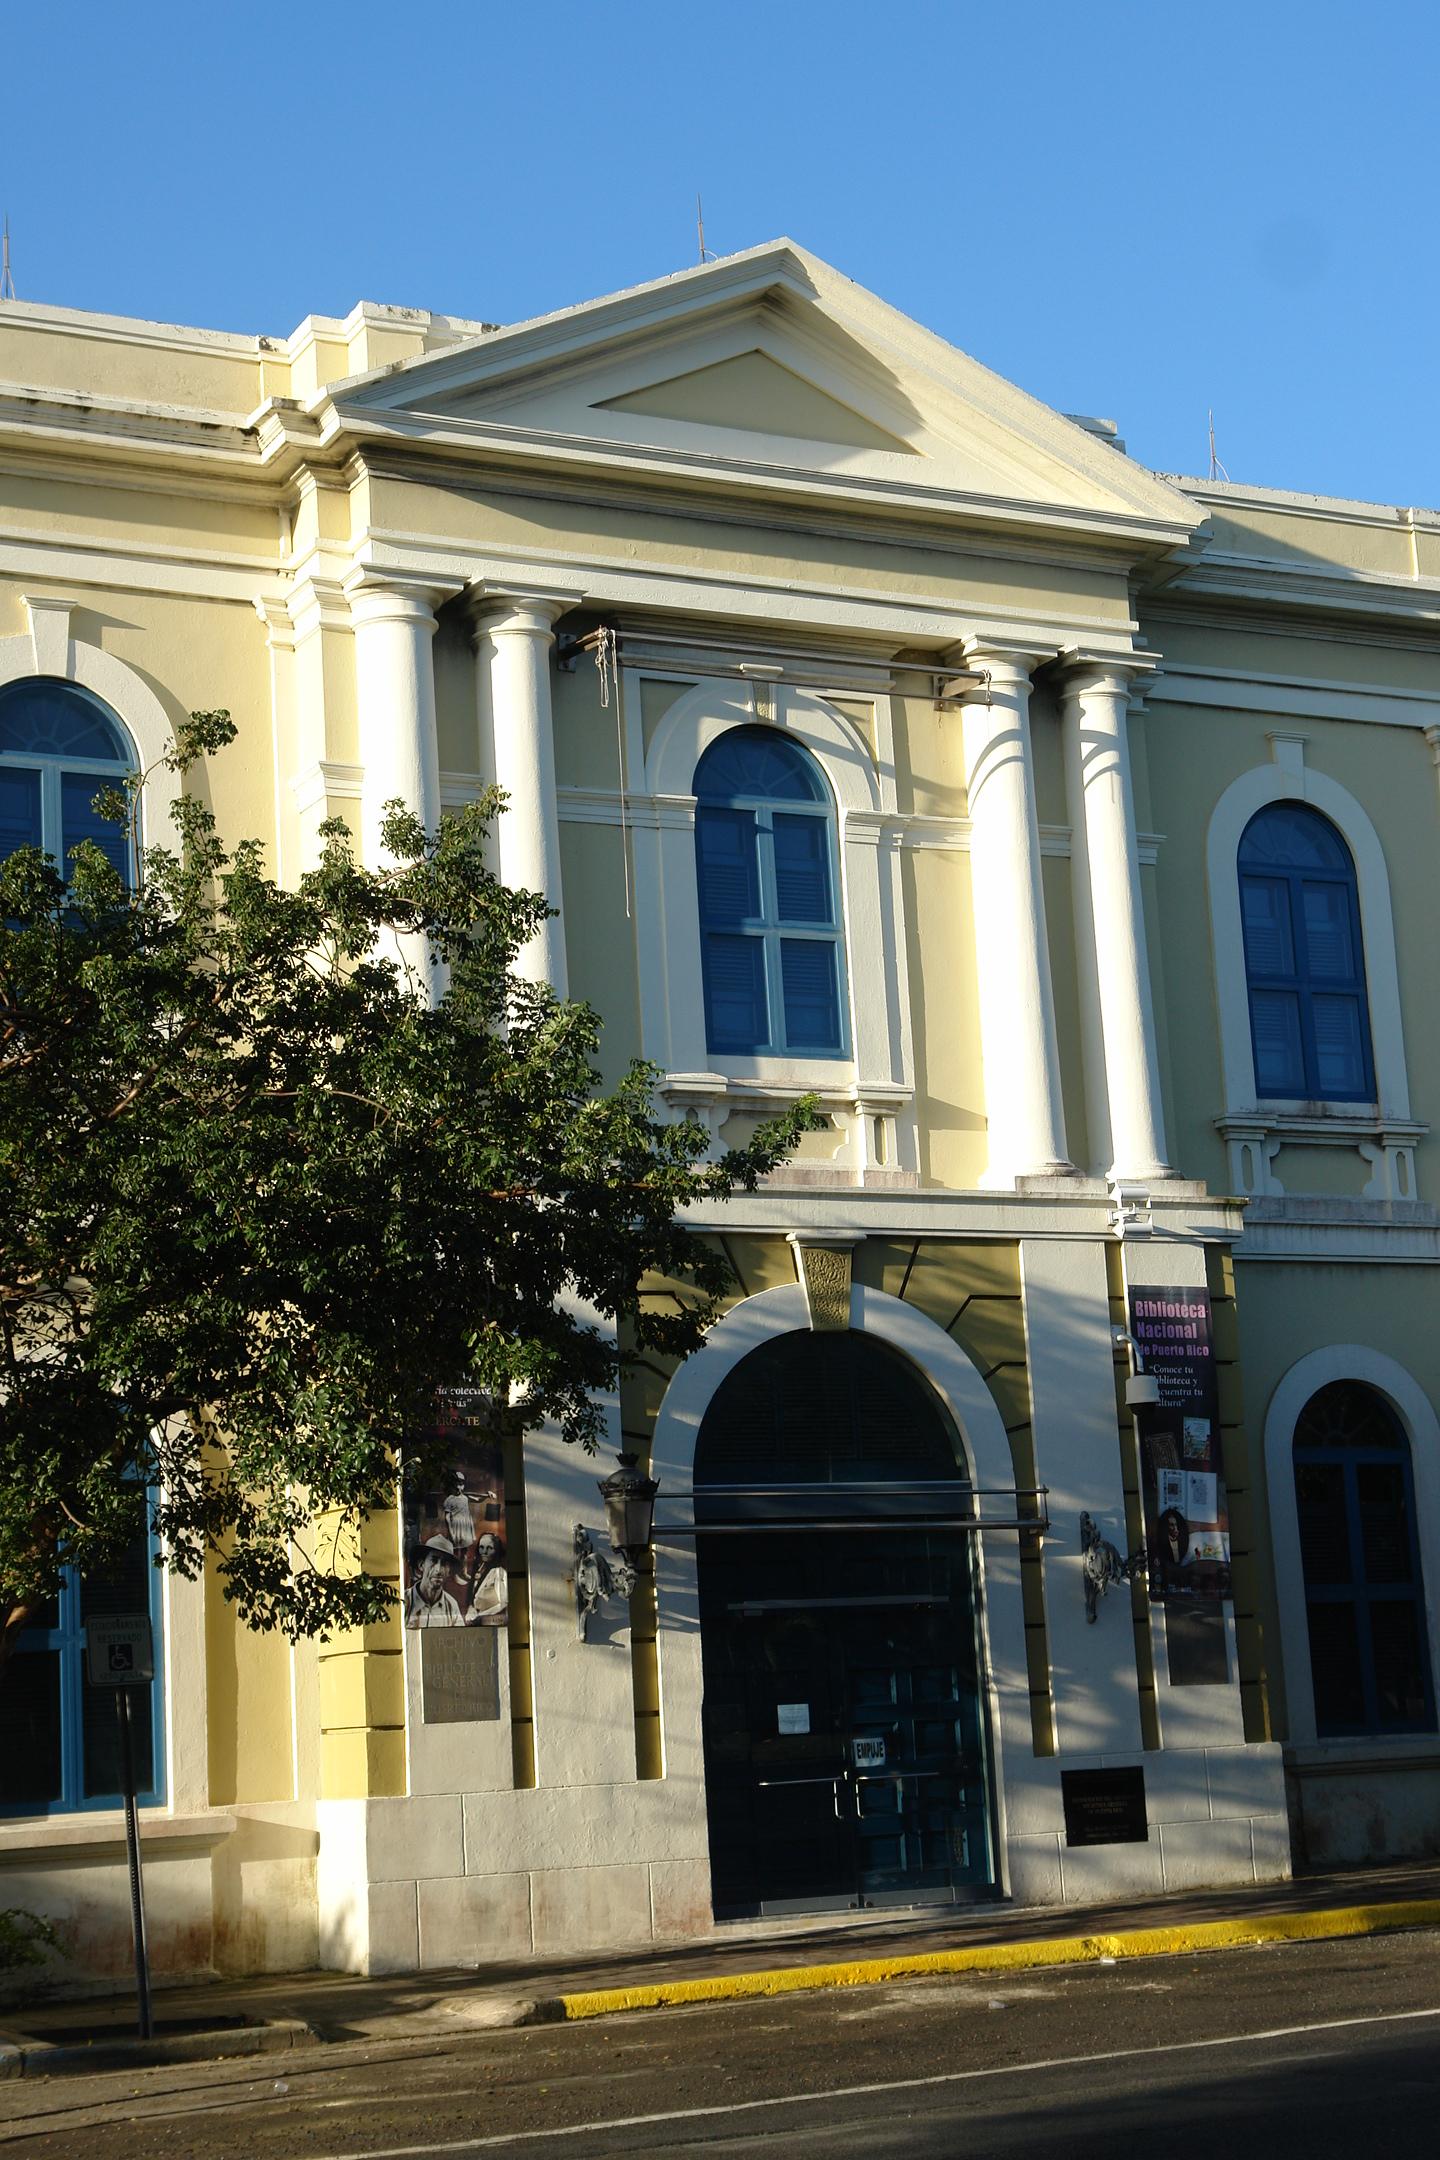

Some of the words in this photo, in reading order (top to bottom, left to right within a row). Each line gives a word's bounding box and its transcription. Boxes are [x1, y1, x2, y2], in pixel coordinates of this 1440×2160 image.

[1135, 1301, 1206, 1318] Biblioteca
[1137, 1321, 1198, 1339] Nacional
[1152, 1344, 1185, 1356] Puerto
[1187, 1345, 1210, 1356] Rico
[1184, 1366, 1194, 1374] tu
[1155, 1375, 1191, 1385] iblioteca
[1192, 1378, 1198, 1387] y
[1194, 1388, 1203, 1397] tu
[432, 1676, 488, 1688] GENERAL
[856, 1741, 884, 1759] EMPUJE
